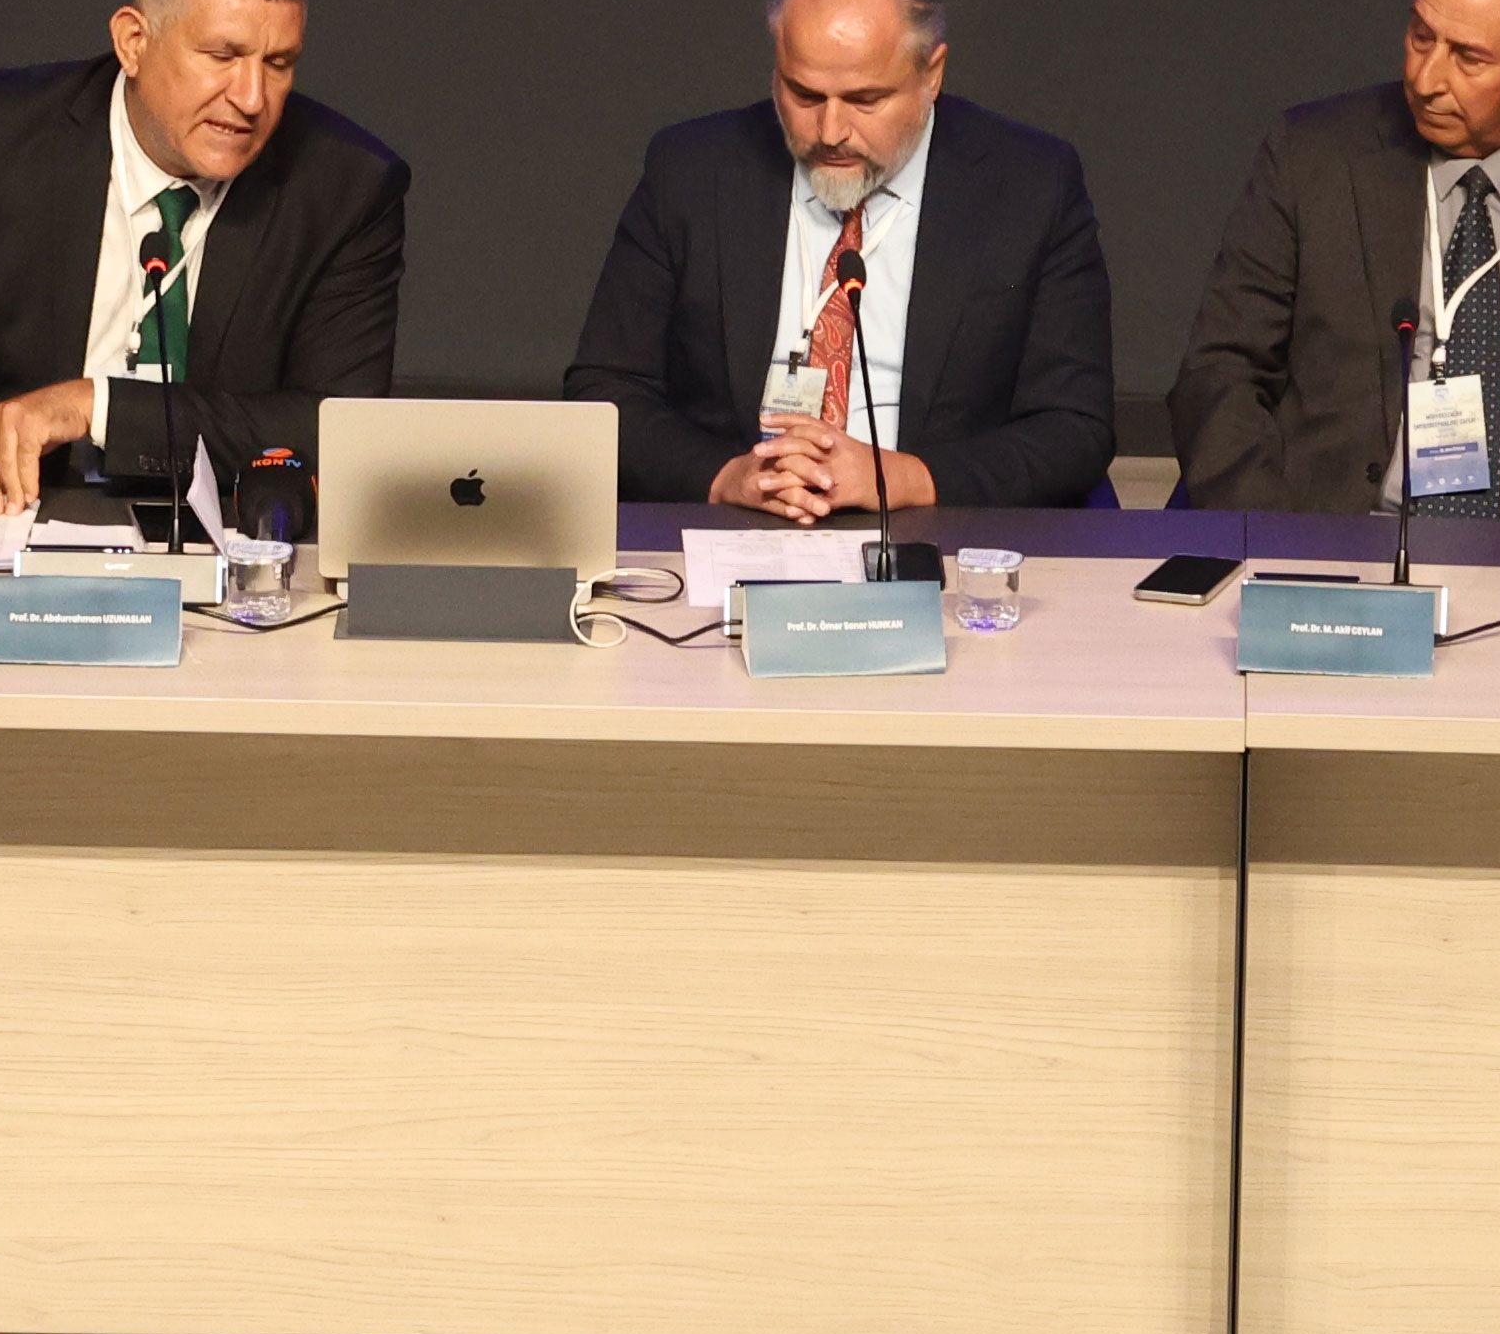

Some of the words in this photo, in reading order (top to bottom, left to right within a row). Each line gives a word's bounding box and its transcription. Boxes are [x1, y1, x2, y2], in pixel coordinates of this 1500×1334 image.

[9, 612, 29, 623] Prof.
[30, 613, 42, 623] Dr.
[787, 622, 806, 632] Prof.
[807, 622, 819, 631] Dr.
[1291, 623, 1309, 633] Prof.
[1311, 624, 1322, 634] Dr.
[1323, 625, 1333, 634] M.
[1351, 626, 1383, 637] CEYLAN
